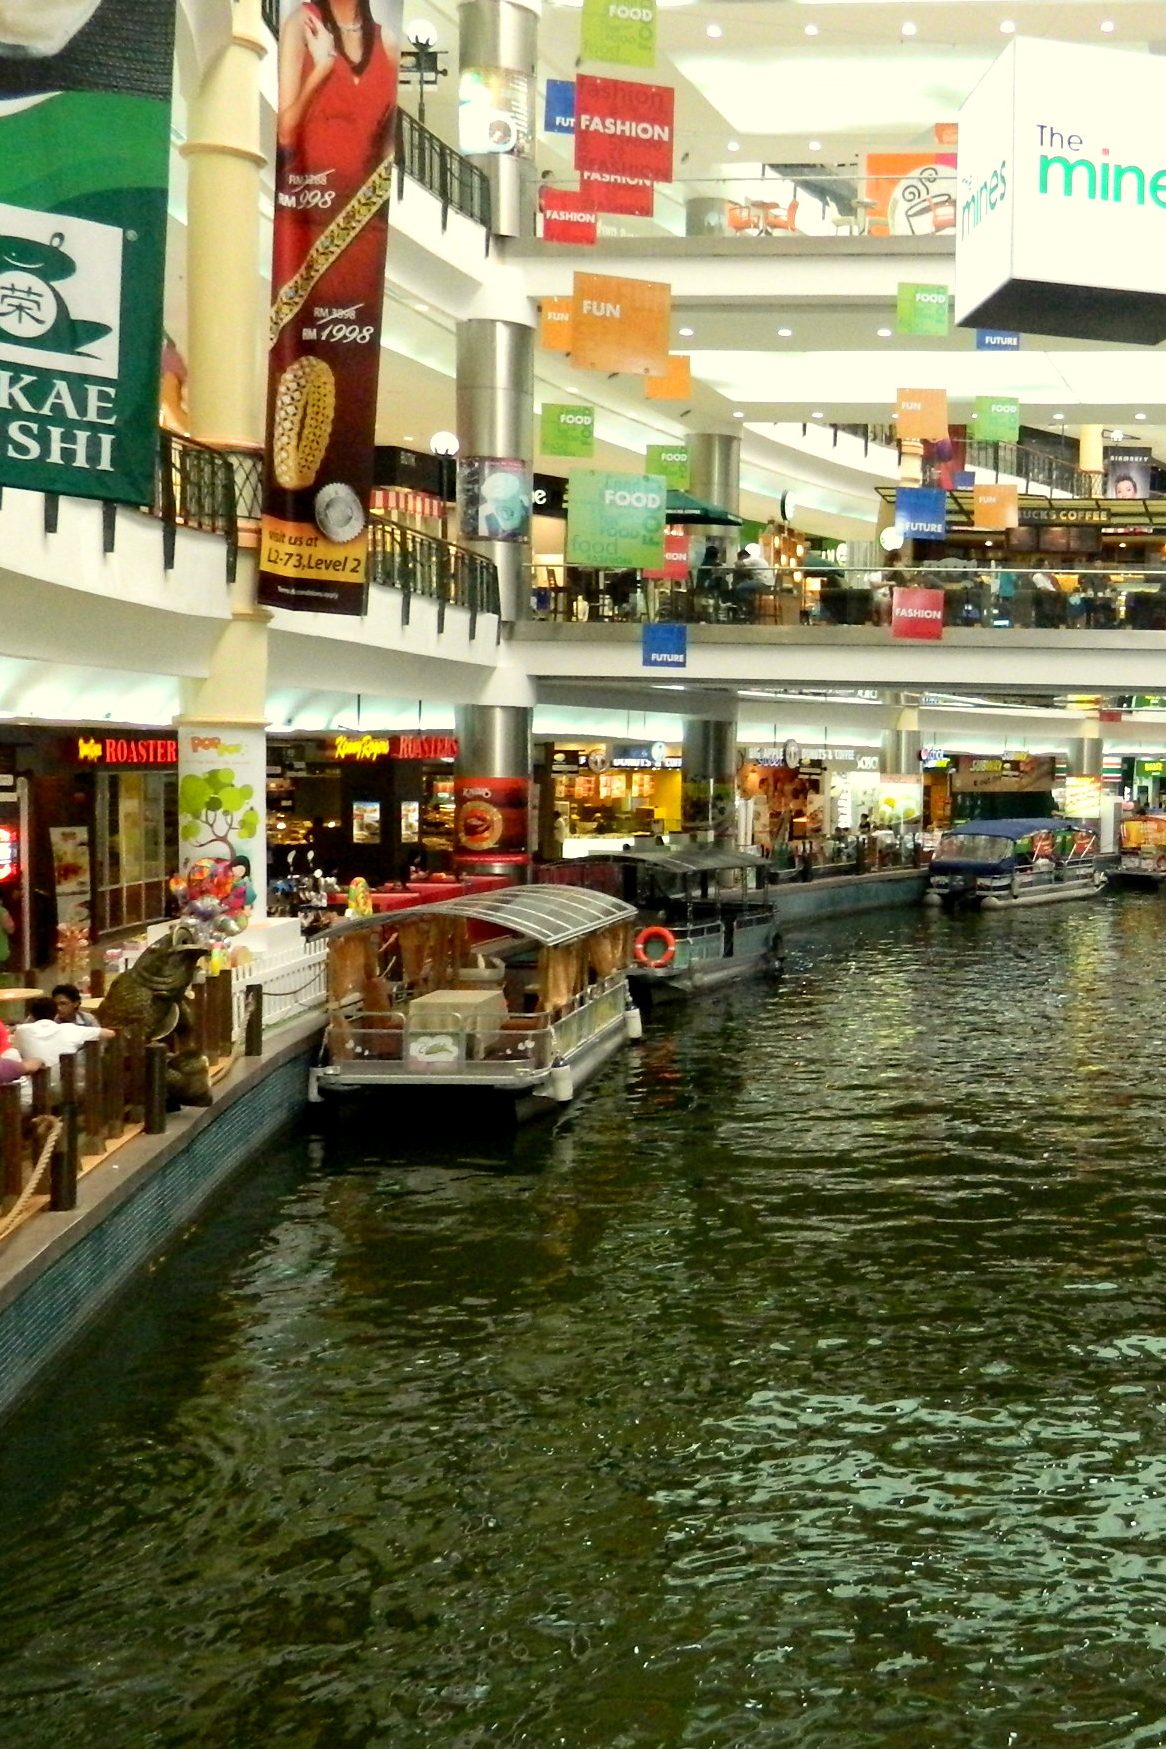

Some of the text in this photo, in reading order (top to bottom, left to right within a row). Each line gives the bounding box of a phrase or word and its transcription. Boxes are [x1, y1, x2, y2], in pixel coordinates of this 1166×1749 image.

[609, 5, 652, 22] FOOD
[556, 116, 575, 127] FUT
[580, 114, 669, 141] FASHION
[1036, 125, 1083, 151] The
[278, 190, 335, 209] RM 998
[962, 160, 1007, 240] mines
[546, 210, 596, 223] FASHION
[915, 293, 946, 304] FOOD
[582, 300, 621, 319] FUN
[547, 312, 569, 322] FUN
[302, 324, 374, 344] RM 1998
[985, 336, 1018, 346] FUTURE
[0, 370, 117, 425] KAE
[901, 402, 921, 411] FUN
[991, 404, 1018, 413] FOOD
[560, 414, 592, 426] FOOD
[7, 420, 115, 471] SHI
[661, 453, 688, 462] FOOD
[604, 489, 661, 509] FOOD
[979, 496, 996, 504] FUN
[1060, 510, 1108, 521] COFFEE
[906, 522, 942, 533] FUTURE
[288, 535, 304, 546] us
[305, 536, 318, 548] at
[306, 554, 347, 572] Level
[348, 557, 362, 573] 2
[895, 607, 942, 620] FASHION
[652, 653, 685, 664] FUTURE
[105, 739, 177, 763] ROASTER
